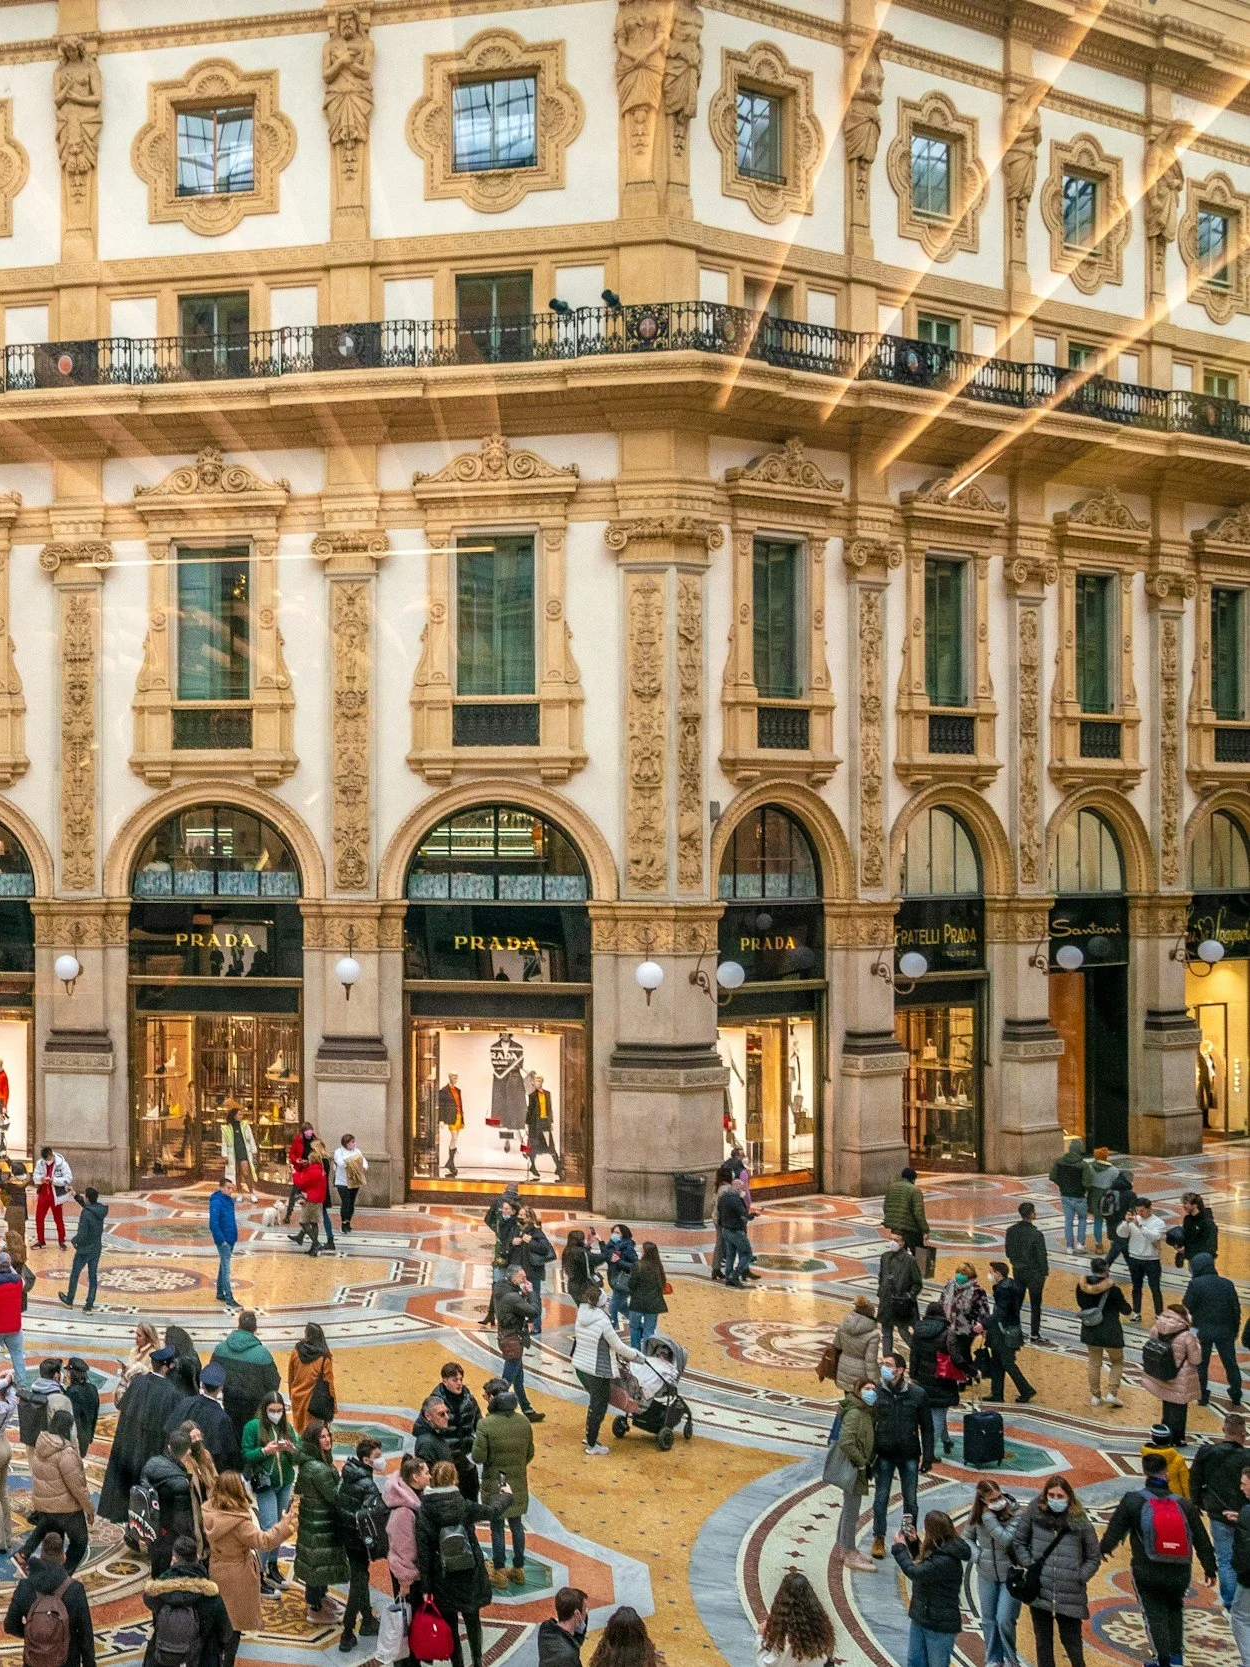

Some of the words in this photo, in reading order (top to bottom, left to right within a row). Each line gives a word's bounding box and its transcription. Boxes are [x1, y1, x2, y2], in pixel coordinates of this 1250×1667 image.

[895, 925, 940, 946] FRATELLI
[944, 923, 977, 944] PRADA
[1049, 918, 1122, 937] Santoni
[175, 933, 256, 948] PRADA
[454, 935, 540, 951] PRADA
[740, 935, 796, 951] PRADA
[490, 1052, 519, 1060] RADA
